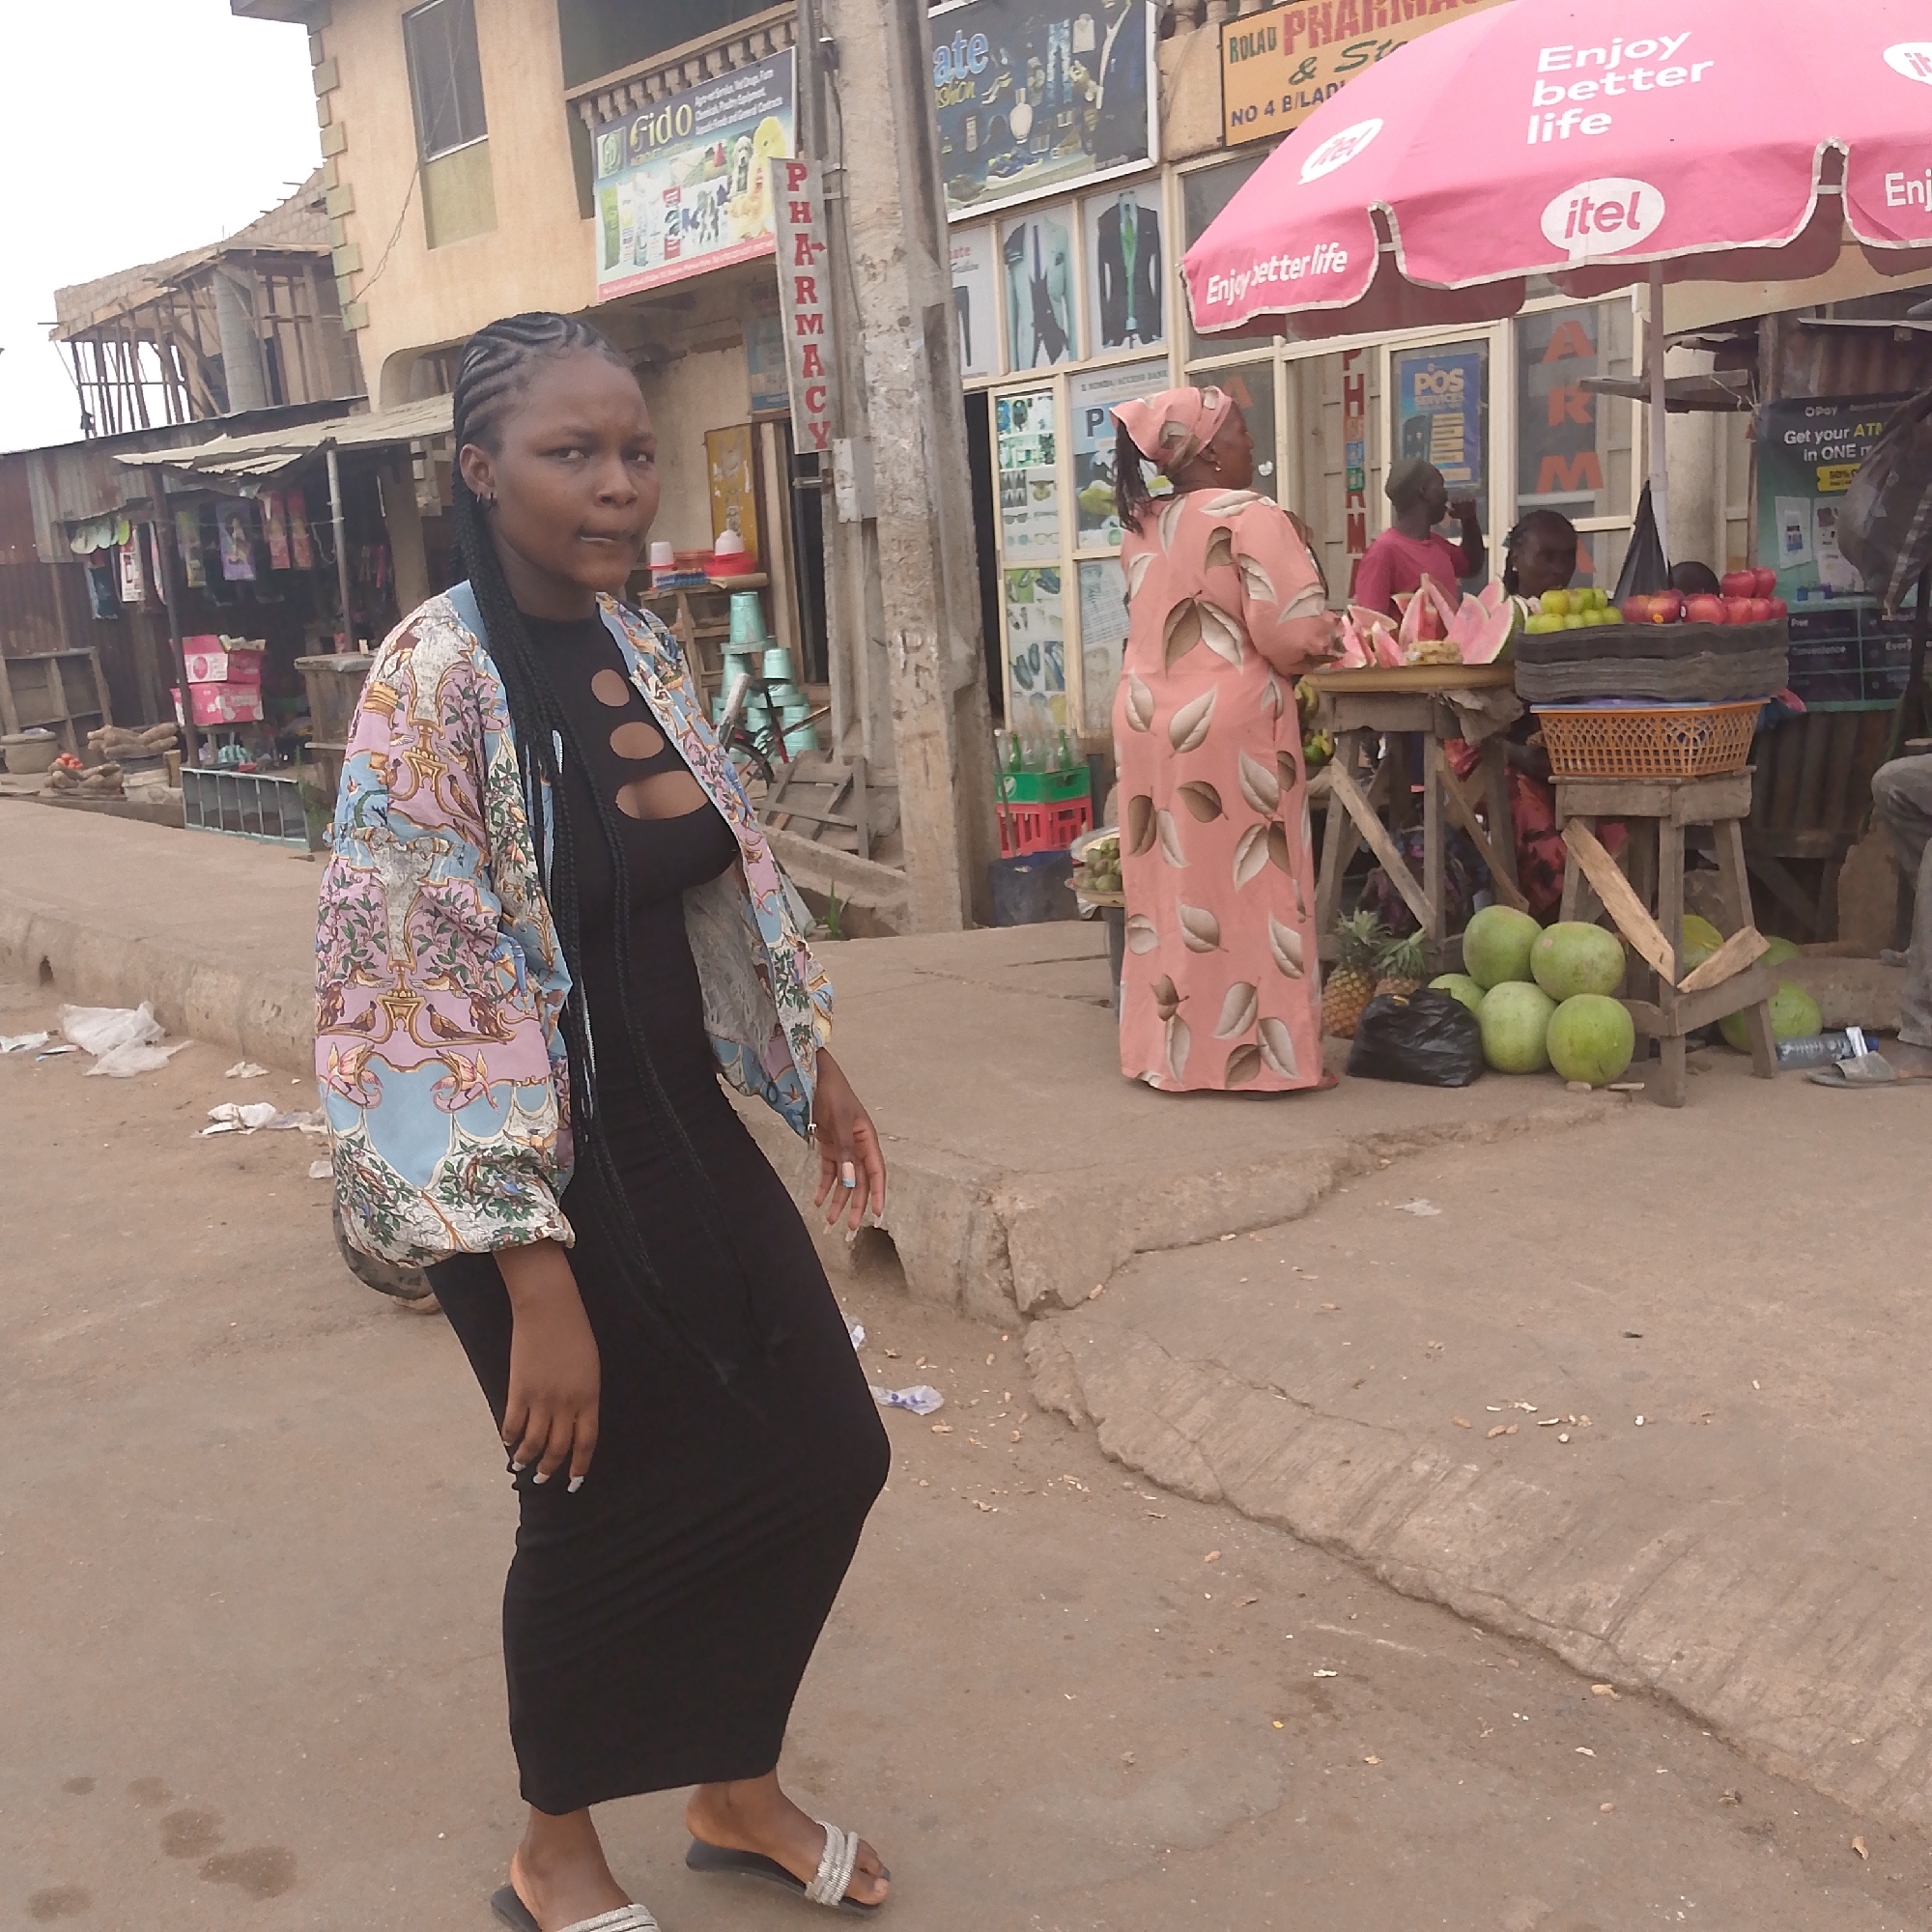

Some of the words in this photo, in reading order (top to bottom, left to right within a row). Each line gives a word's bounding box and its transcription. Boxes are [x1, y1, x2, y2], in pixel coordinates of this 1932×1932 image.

[1283, 0, 1483, 56] PHARM
[933, 29, 989, 88] ate
[1289, 56, 1317, 85] &
[1537, 32, 1691, 72] Enjoy
[1903, 52, 1932, 77] it
[1532, 60, 1714, 107] better
[1231, 105, 1258, 127] NO
[1264, 99, 1275, 116] 4
[1526, 108, 1612, 144] life
[1886, 168, 1932, 213] Enj
[1564, 191, 1641, 240] itel
[1207, 269, 1251, 306] Enjoy
[1310, 242, 1349, 274] life
[785, 162, 832, 450] PHARMACY
[1414, 368, 1464, 396] POS
[1784, 429, 1811, 445] Get
[1815, 427, 1850, 445] your
[1821, 443, 1857, 461] ONE
